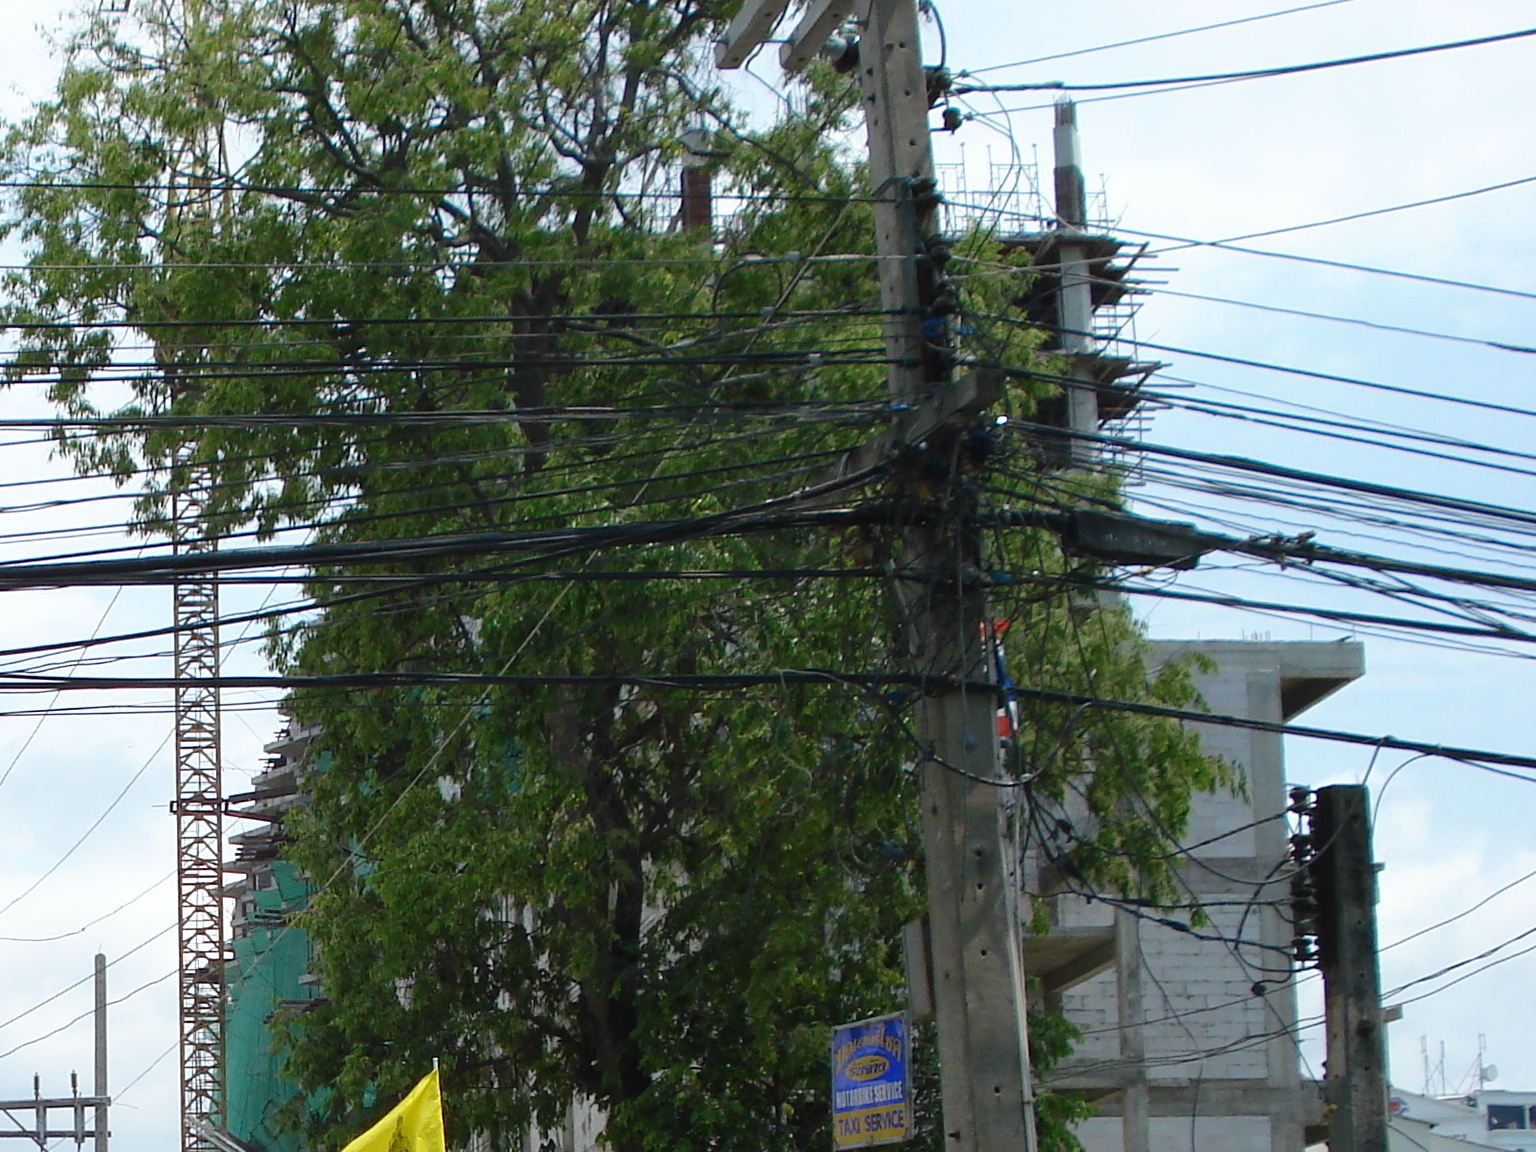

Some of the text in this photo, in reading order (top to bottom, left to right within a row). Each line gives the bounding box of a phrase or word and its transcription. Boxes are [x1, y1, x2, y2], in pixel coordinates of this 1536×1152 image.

[874, 1081, 903, 1102] SERVICE
[838, 1110, 904, 1137] TAXI SERVICE
